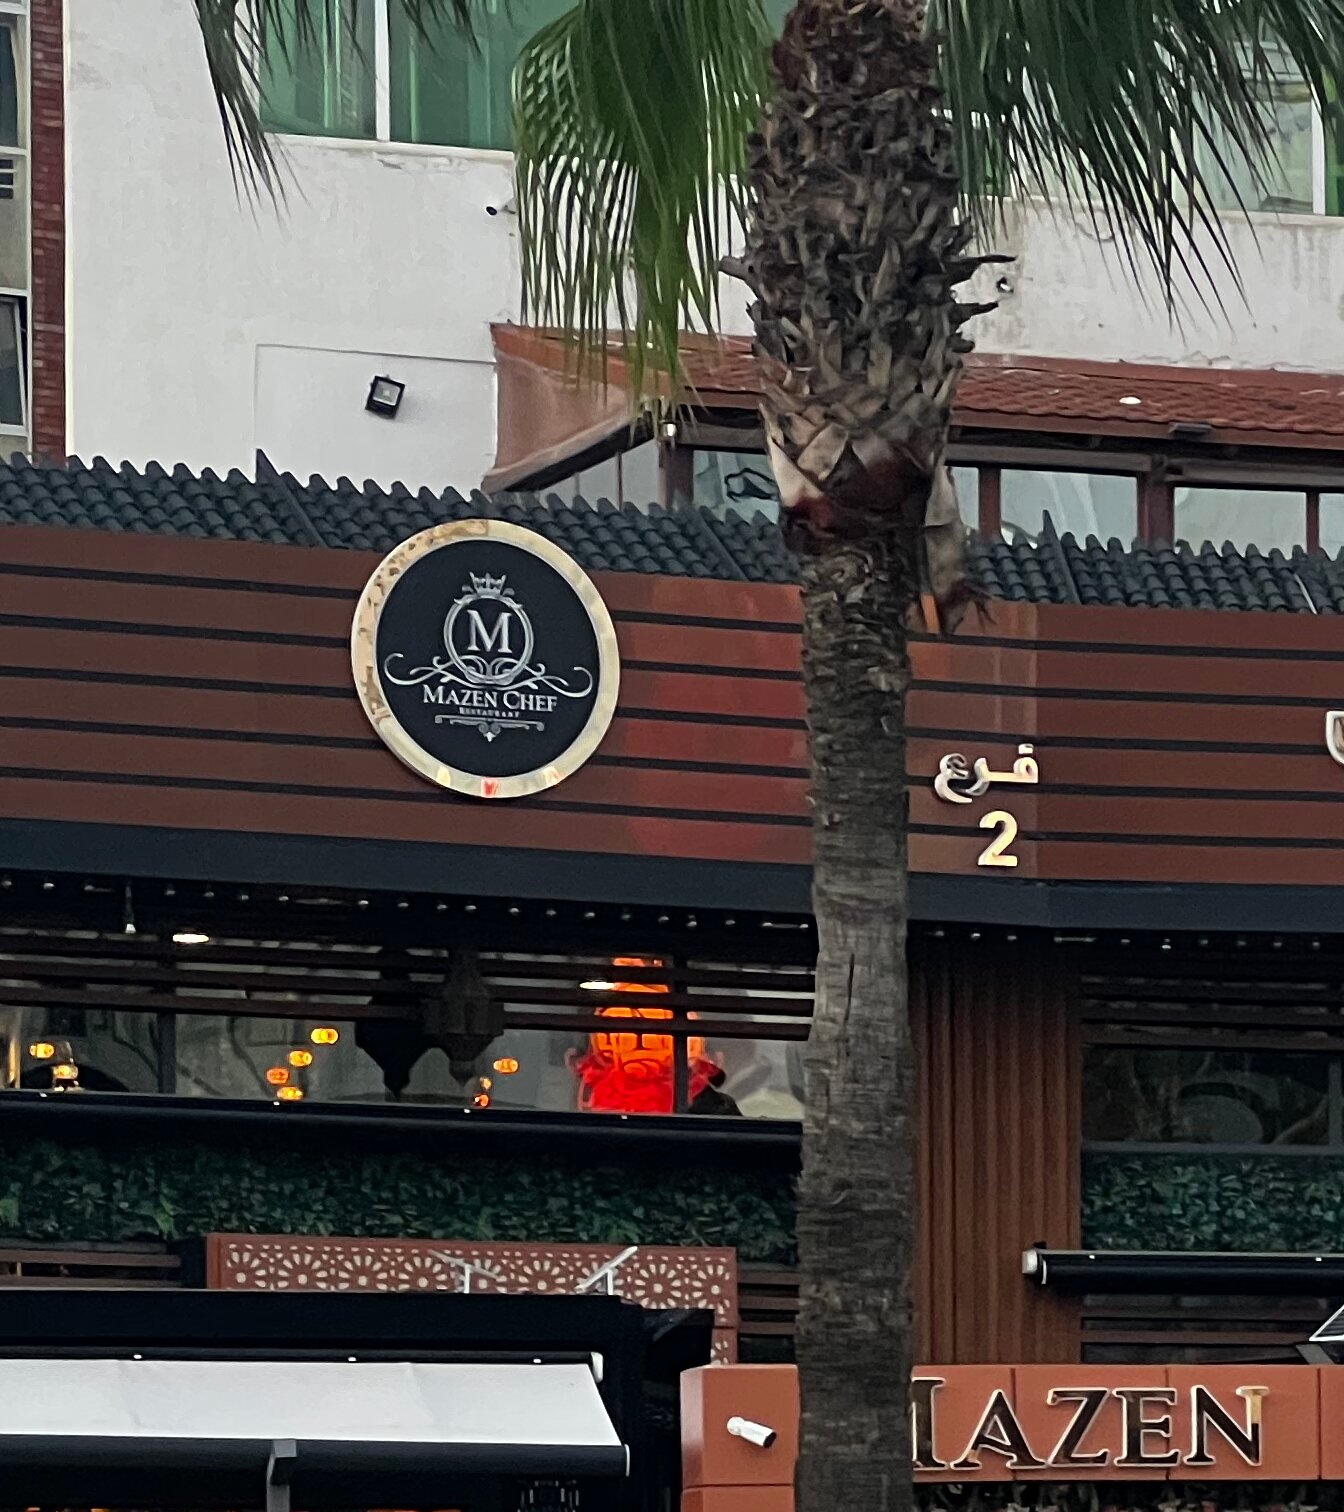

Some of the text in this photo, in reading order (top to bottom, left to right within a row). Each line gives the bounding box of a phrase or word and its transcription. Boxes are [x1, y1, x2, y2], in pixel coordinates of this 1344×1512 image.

[467, 608, 513, 653] M
[422, 684, 557, 712] MAZEN CHEF
[934, 743, 1039, 804] فرع
[977, 810, 1018, 867] 2
